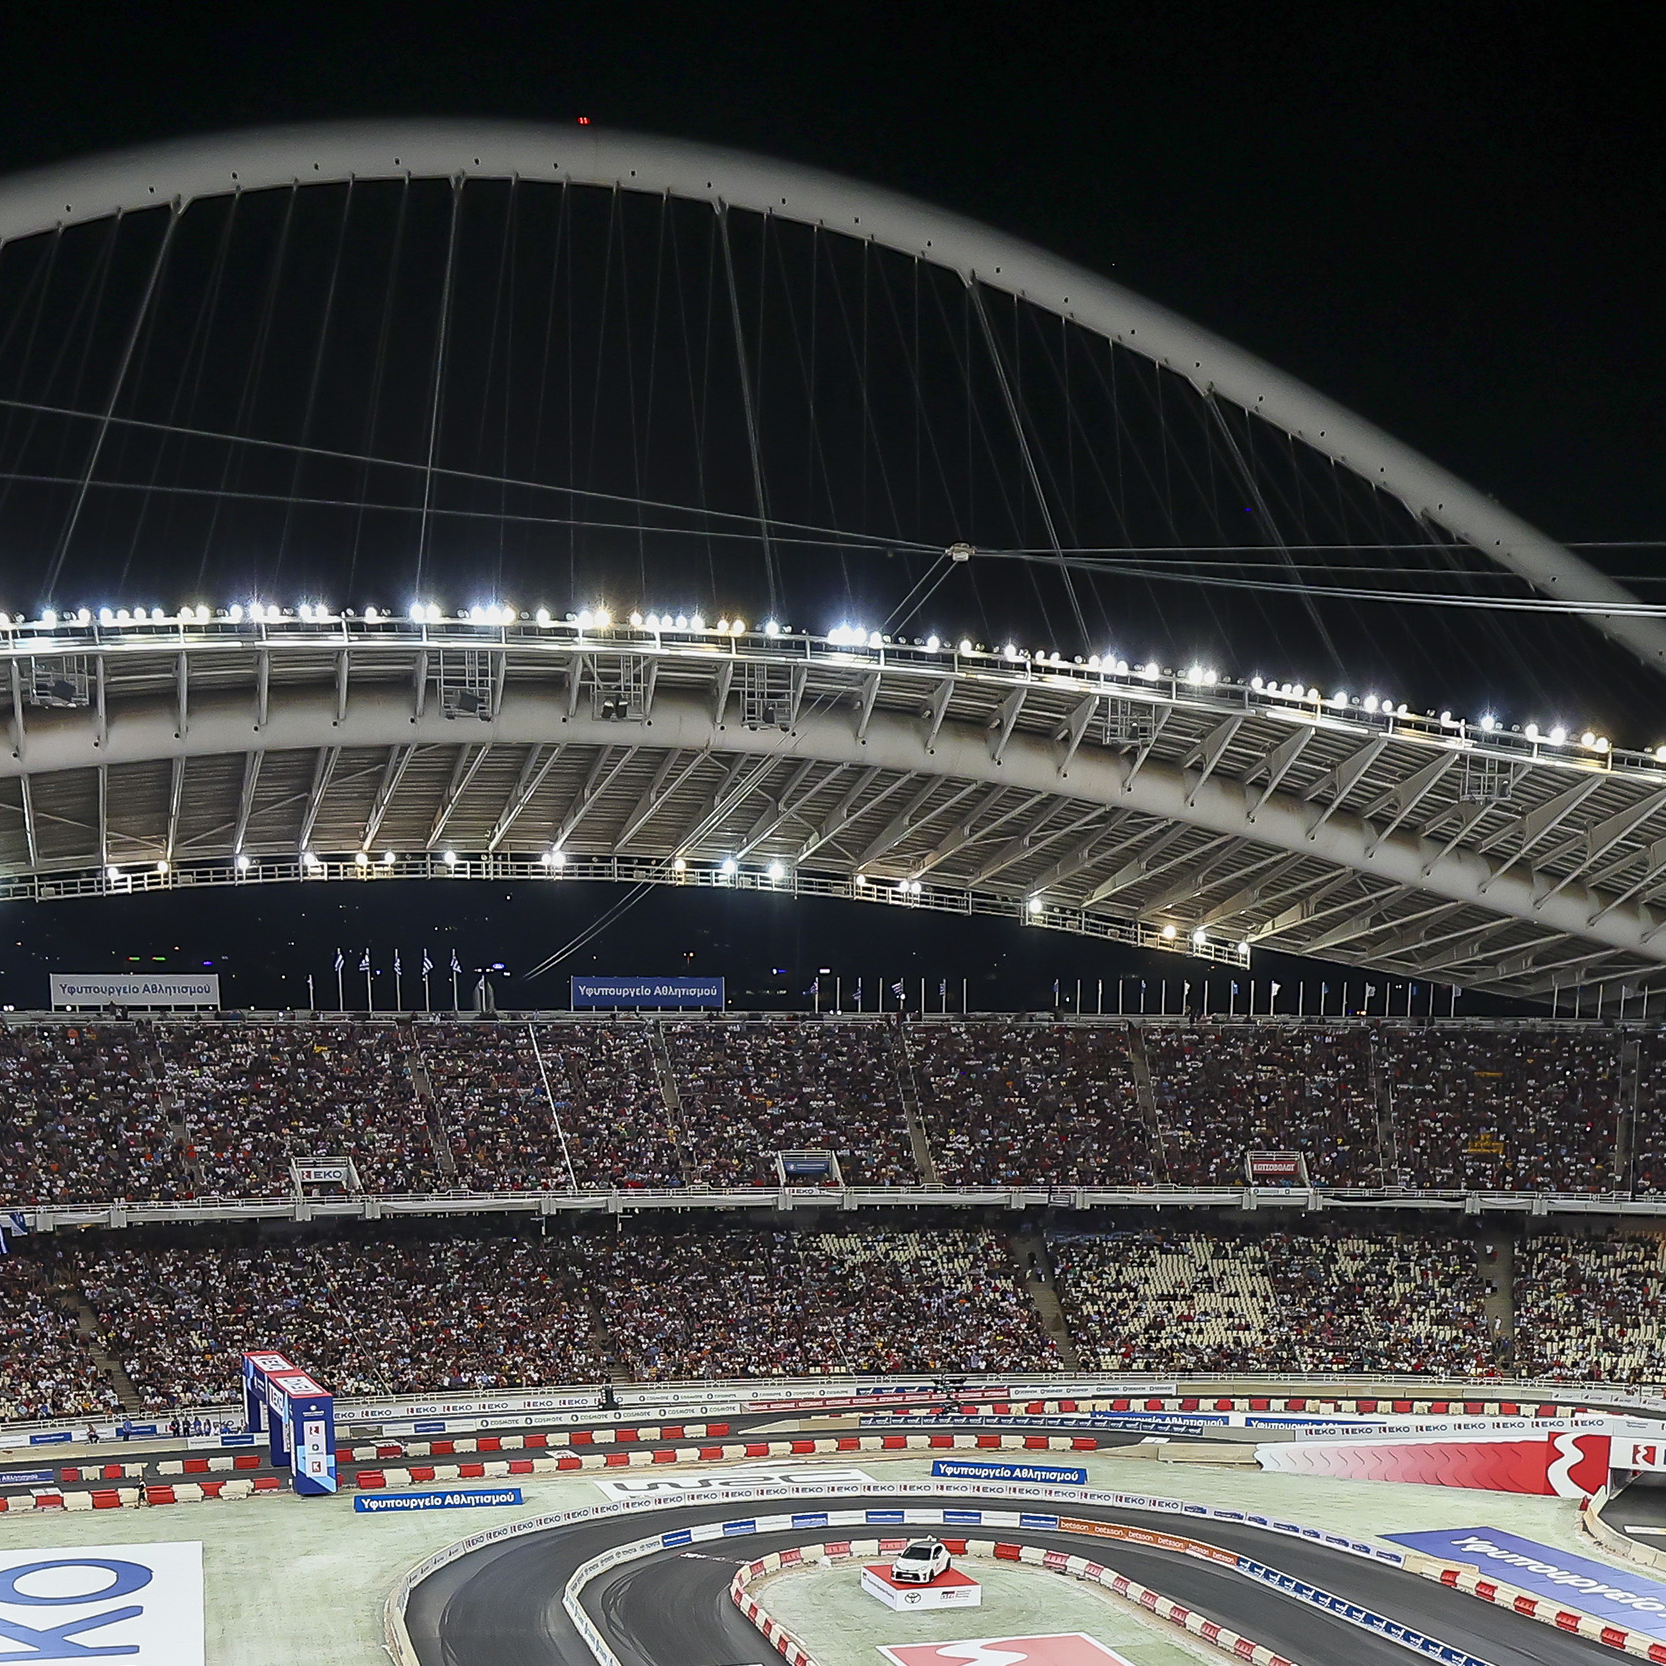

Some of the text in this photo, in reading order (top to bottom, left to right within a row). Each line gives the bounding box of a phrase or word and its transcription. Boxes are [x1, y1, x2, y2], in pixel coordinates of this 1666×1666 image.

[59, 984, 211, 996] Υφυπουργείο Αθλητισμού
[578, 985, 717, 997] Υφυπουργείο Αθλητισμού
[313, 1171, 342, 1179] EKO
[939, 1463, 1079, 1482] Υφυπουργείο Αθλητισμού
[362, 1491, 515, 1510] Υφυπουργείο Αθλητισμού
[472, 1536, 483, 1546] EKO
[493, 1529, 508, 1538] EKO
[518, 1522, 533, 1531] EKO
[544, 1516, 560, 1525] EKO
[571, 1510, 588, 1519] EKO
[600, 1505, 618, 1513] EKO
[663, 1496, 682, 1504] EKO
[697, 1493, 717, 1501] EKO
[1018, 1487, 1040, 1495] EKO
[1090, 1493, 1111, 1501] EKO
[1124, 1496, 1145, 1504] EKO
[1158, 1500, 1179, 1509] EKO
[1061, 1521, 1089, 1531] betsson
[1095, 1524, 1124, 1536] betsson
[1128, 1531, 1154, 1541] betsson
[1158, 1537, 1184, 1547] betsson
[1450, 1534, 1666, 1615] Υφυπουργείο
